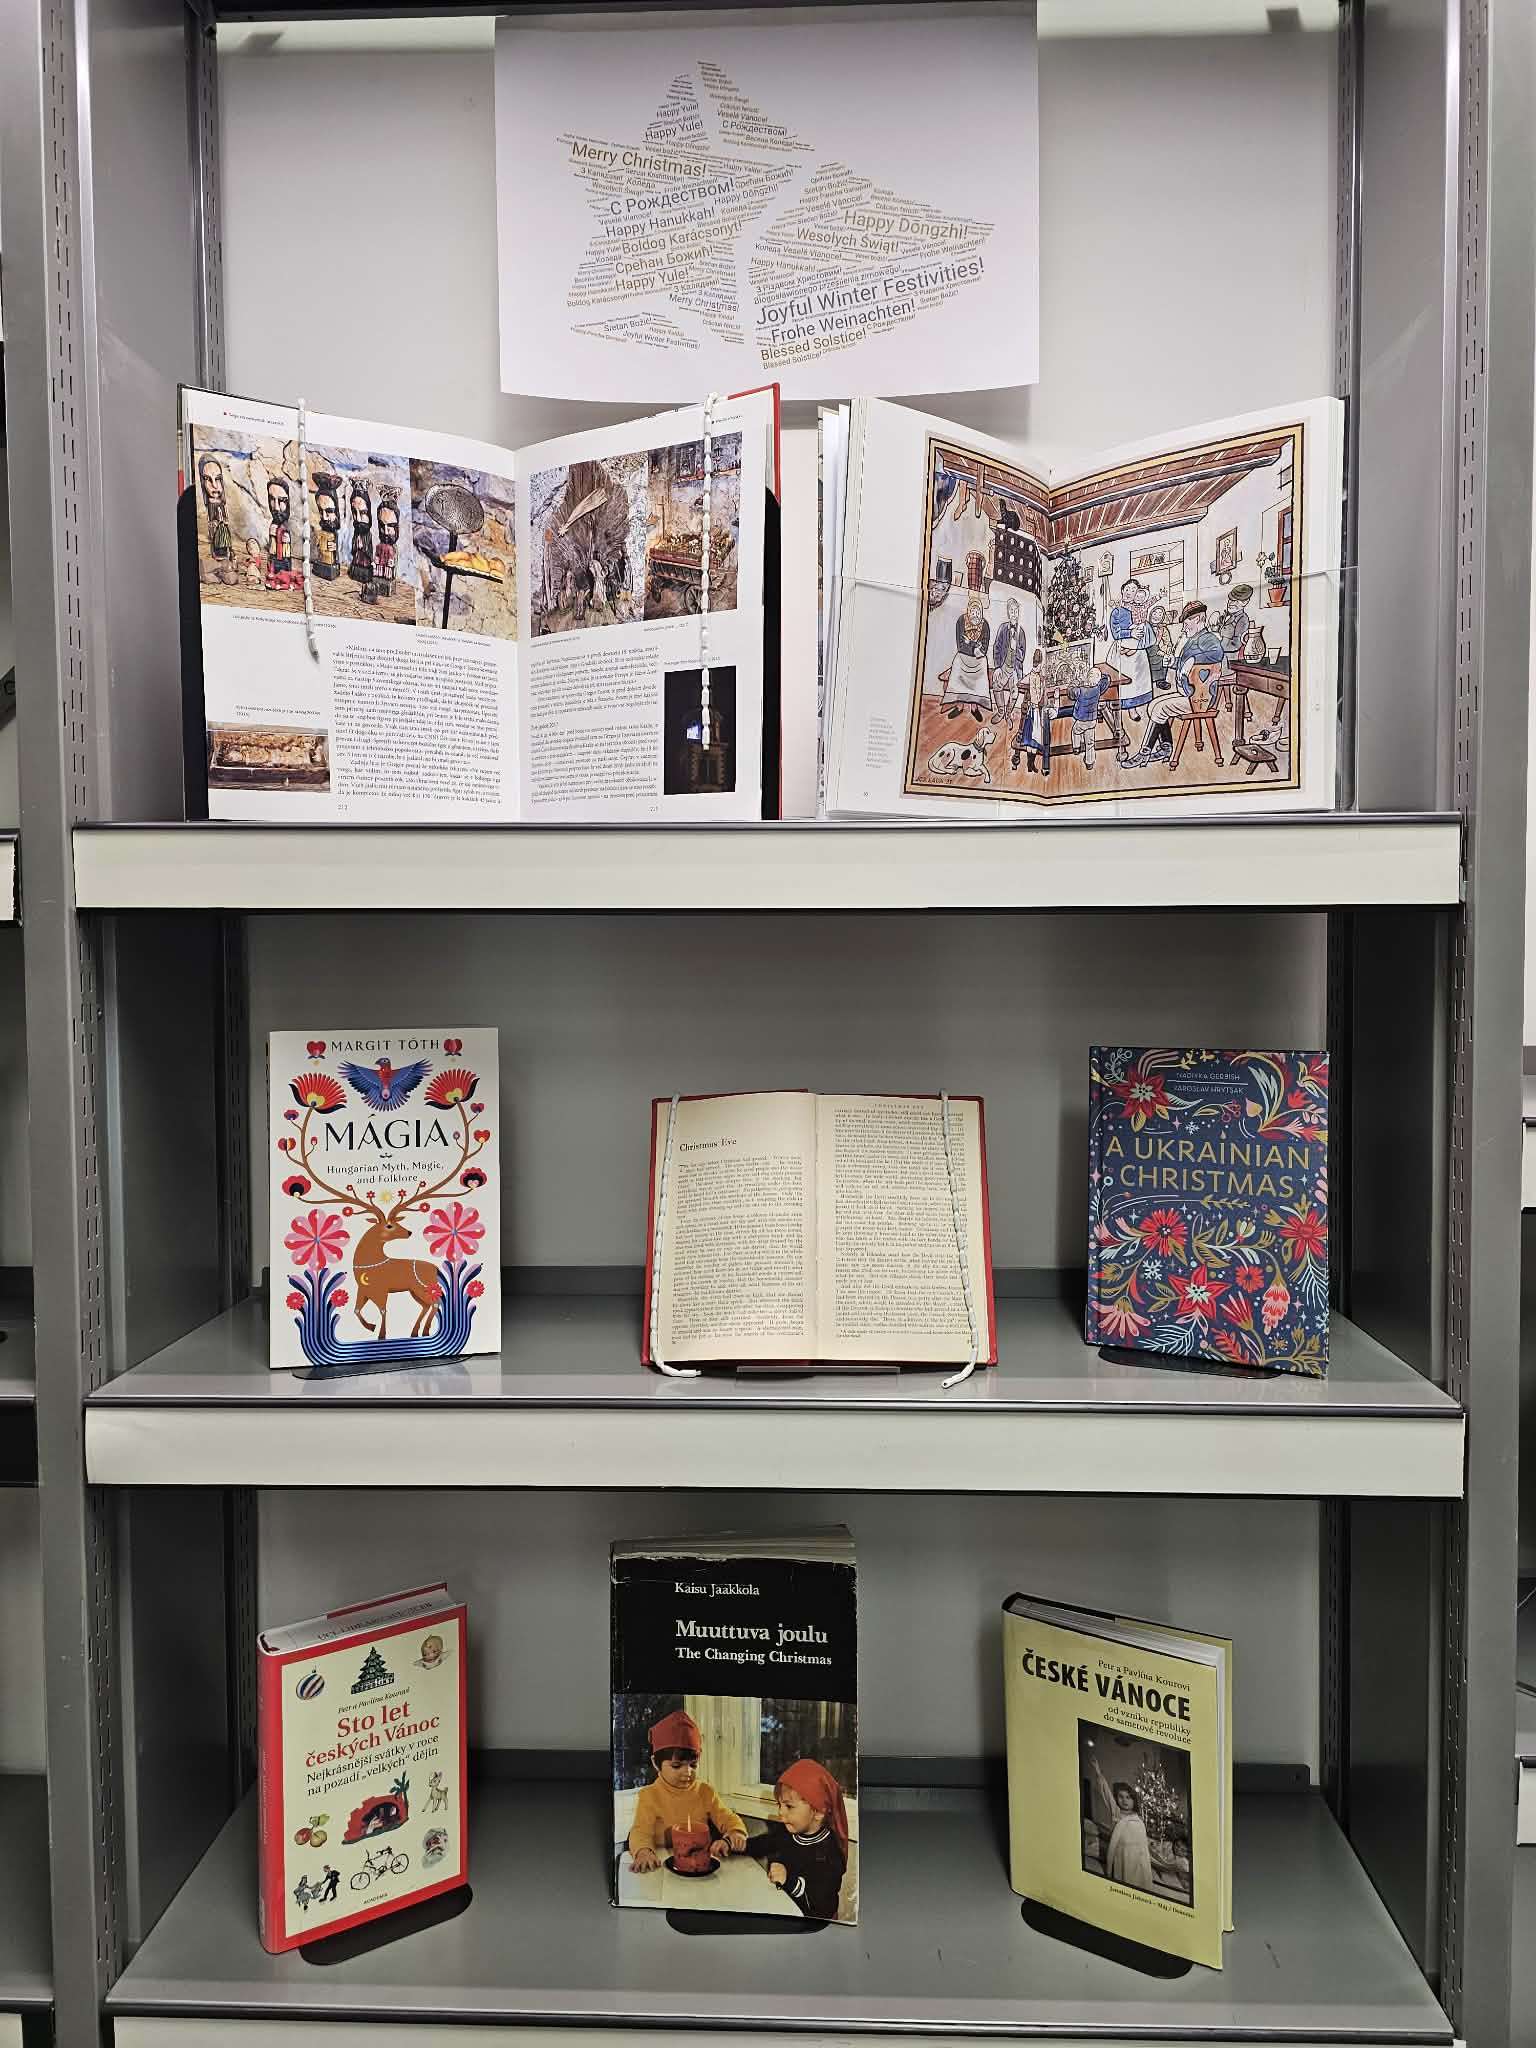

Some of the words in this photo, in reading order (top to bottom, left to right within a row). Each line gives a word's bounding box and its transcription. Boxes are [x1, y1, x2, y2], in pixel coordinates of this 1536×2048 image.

[656, 107, 680, 119] Happy
[645, 126, 677, 140] Happy
[679, 120, 704, 132] Yule!
[730, 121, 788, 136] Рождеством!
[572, 141, 618, 167] Merry
[622, 151, 706, 177] Christmas!
[626, 177, 735, 213] Рождеством!
[714, 192, 741, 205] Happy
[605, 223, 646, 238] Happy
[649, 206, 715, 230] Hanukkah!
[844, 210, 895, 235] Happy
[622, 238, 666, 255] Boldog
[669, 221, 742, 246] Karácsonyt!
[860, 233, 899, 254] Świąt!
[615, 257, 664, 276] Срећан
[666, 245, 713, 265] Божић!
[751, 257, 774, 268] Happy
[776, 260, 816, 272] Hanukkah!
[615, 276, 655, 291] Happy
[658, 267, 689, 283] Yule!
[756, 299, 813, 325] Joyful
[817, 285, 878, 311] Winter
[883, 256, 985, 296] Festivities!
[669, 293, 693, 307] Merry
[695, 298, 740, 312] Christmas!
[771, 323, 816, 343] Frohe
[818, 299, 916, 333] Weinachten!
[622, 330, 643, 340] Joyful
[644, 333, 665, 343] Winter
[761, 340, 810, 361] Blessed
[813, 327, 867, 350] Solstice!
[763, 355, 791, 370] Blessed
[792, 348, 822, 364] Solstice!
[331, 1040, 392, 1053] MARGIT
[398, 1036, 440, 1051] TÓTH
[1209, 1072, 1240, 1081] GERBISH
[325, 1113, 449, 1152] MÁGIA
[679, 1140, 718, 1152] Christmas
[721, 1138, 737, 1146] Eve
[1105, 1135, 1124, 1157] A
[1135, 1136, 1310, 1170] UKRAINIAN
[327, 1164, 379, 1176] Hungarian
[381, 1162, 410, 1173] Myth,
[412, 1160, 445, 1172] Magic,
[356, 1174, 375, 1184] and
[378, 1173, 418, 1184] Folklore
[1119, 1164, 1295, 1198] CHRISTMAS
[674, 1582, 707, 1594] Kaisu
[709, 1583, 760, 1597] Jaakkola
[675, 1619, 771, 1640] Muuttuva
[776, 1623, 828, 1646] joulu
[675, 1648, 701, 1659] The
[704, 1648, 765, 1664] Changing
[769, 1650, 832, 1665] Christmas
[1022, 1648, 1089, 1693] ČESKÉ
[1095, 1674, 1191, 1722] VÁNOCE
[1098, 1659, 1114, 1672] Petr
[1123, 1665, 1153, 1682] Pavlína
[1156, 1675, 1191, 1691] Kourovi
[337, 1714, 375, 1738] Sto
[382, 1701, 411, 1722] let
[1104, 1712, 1114, 1721] do
[1116, 1717, 1154, 1734] sametové
[1156, 1728, 1192, 1745] revoluce
[1108, 1705, 1119, 1715] od
[1120, 1709, 1149, 1723] vzniku
[1151, 1718, 1191, 1737] republiky
[305, 1732, 381, 1768] českých
[385, 1716, 440, 1742] Vánoc
[306, 1754, 372, 1784] Nejkrásnější
[374, 1744, 407, 1762] svátky
[408, 1742, 415, 1750] v
[417, 1735, 439, 1748] roce
[307, 1787, 321, 1797] na
[324, 1772, 359, 1793] pozadí
[412, 1747, 438, 1762] dějin
